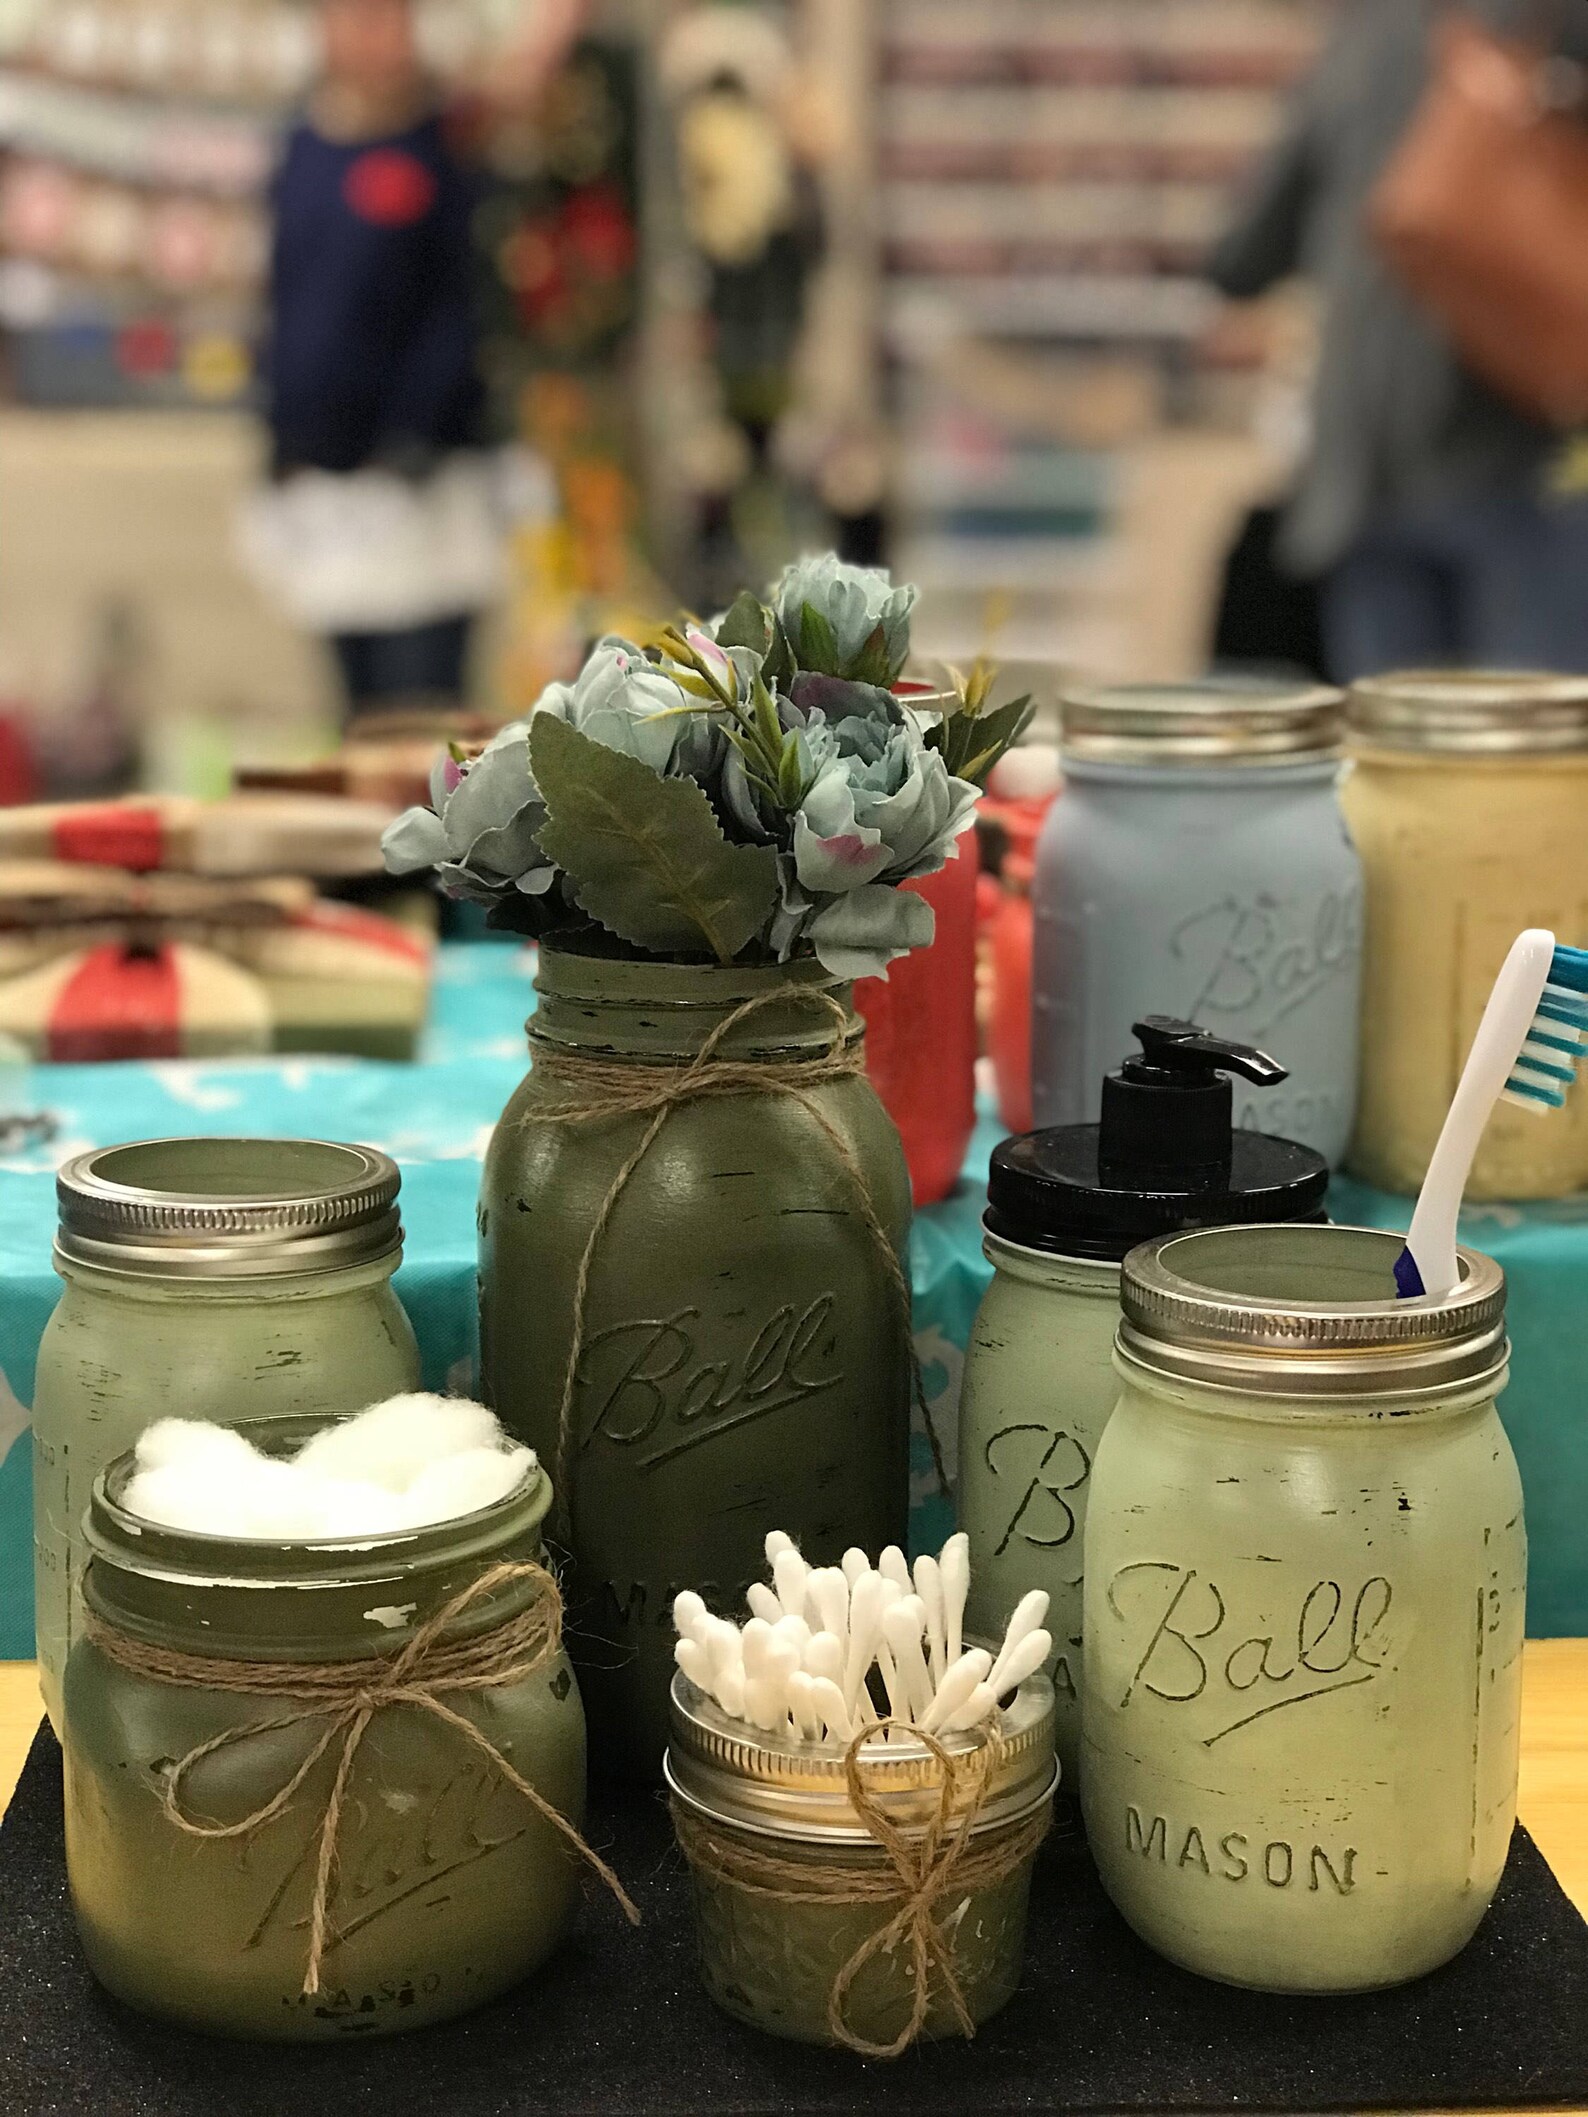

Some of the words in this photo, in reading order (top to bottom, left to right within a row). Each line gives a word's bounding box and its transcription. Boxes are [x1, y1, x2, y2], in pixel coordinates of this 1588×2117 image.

[1171, 886, 1361, 1023] Ball
[575, 1290, 844, 1450] Ball
[1108, 1562, 1395, 1708] Ball
[1126, 1806, 1359, 1896] MASON
